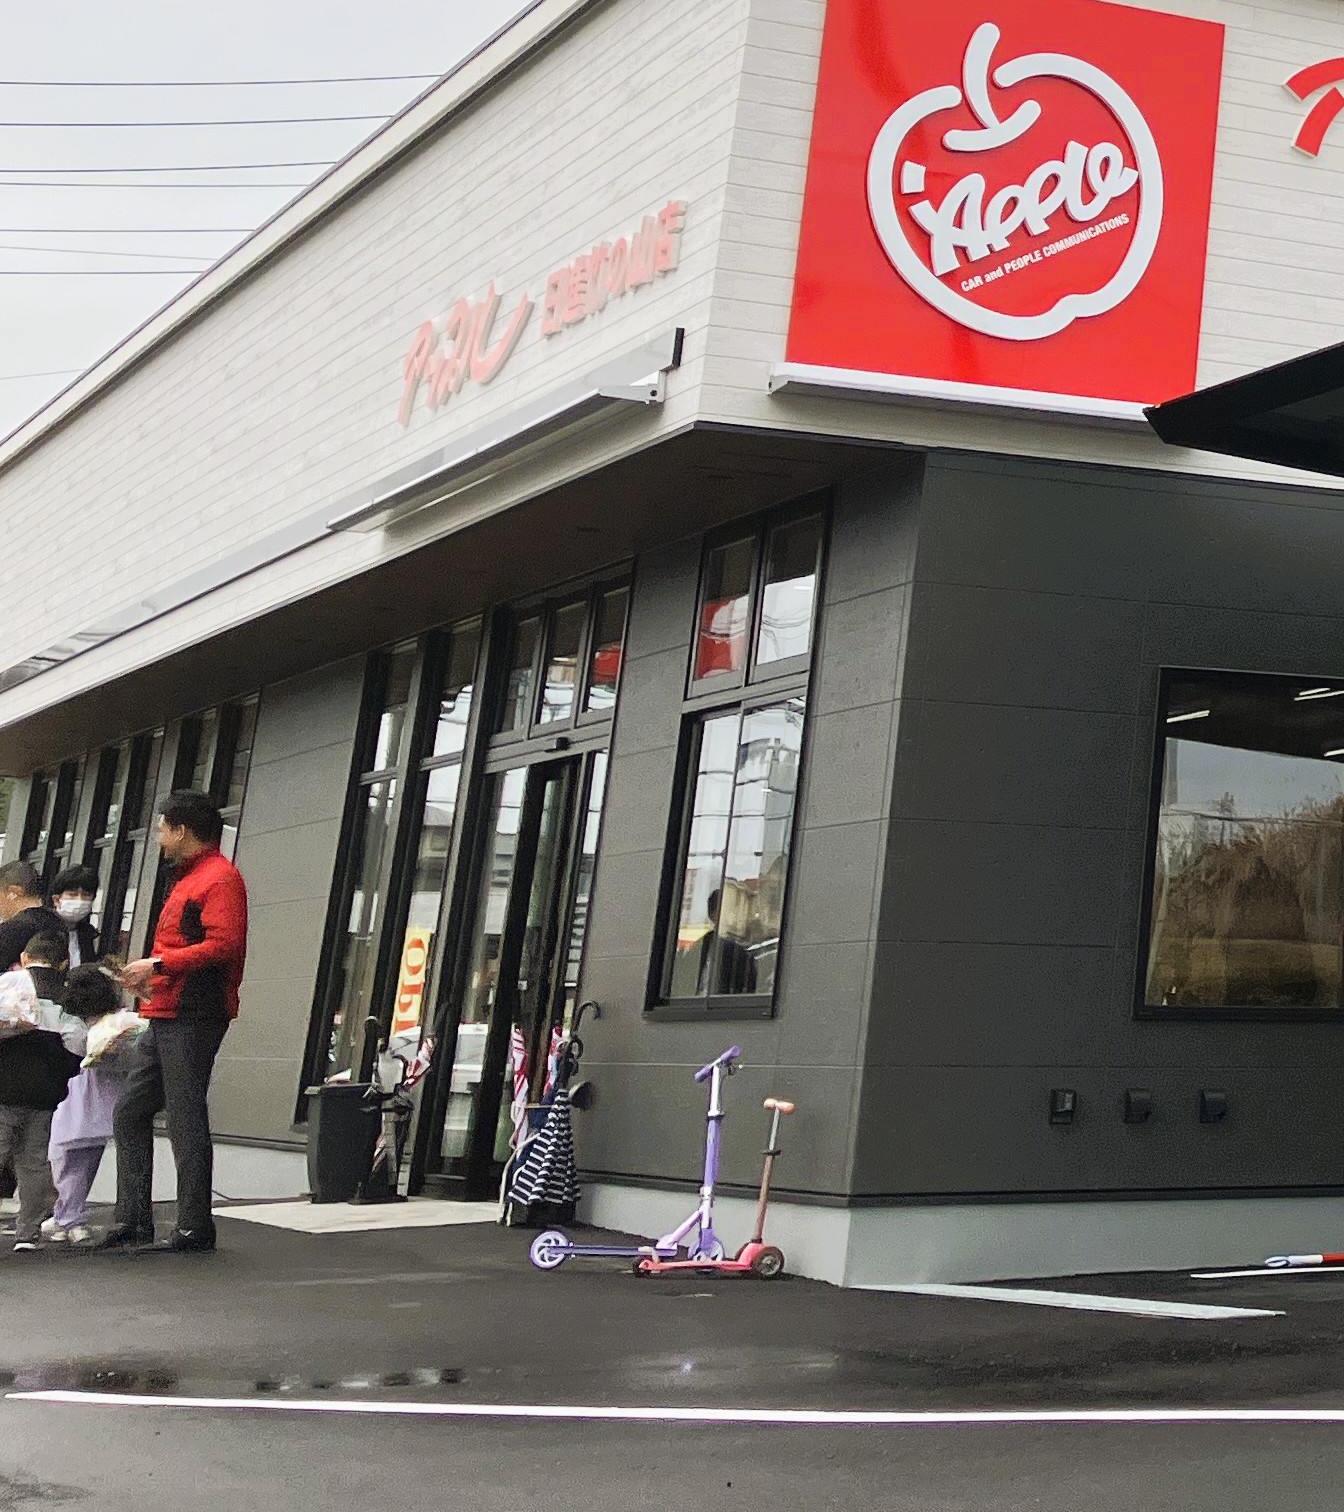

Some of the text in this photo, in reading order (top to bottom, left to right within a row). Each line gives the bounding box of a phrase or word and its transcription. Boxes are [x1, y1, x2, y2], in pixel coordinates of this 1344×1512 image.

[901, 140, 1138, 276] Apple
[960, 213, 1130, 292] CAR and PEOPLE COMMUNICATIONS
